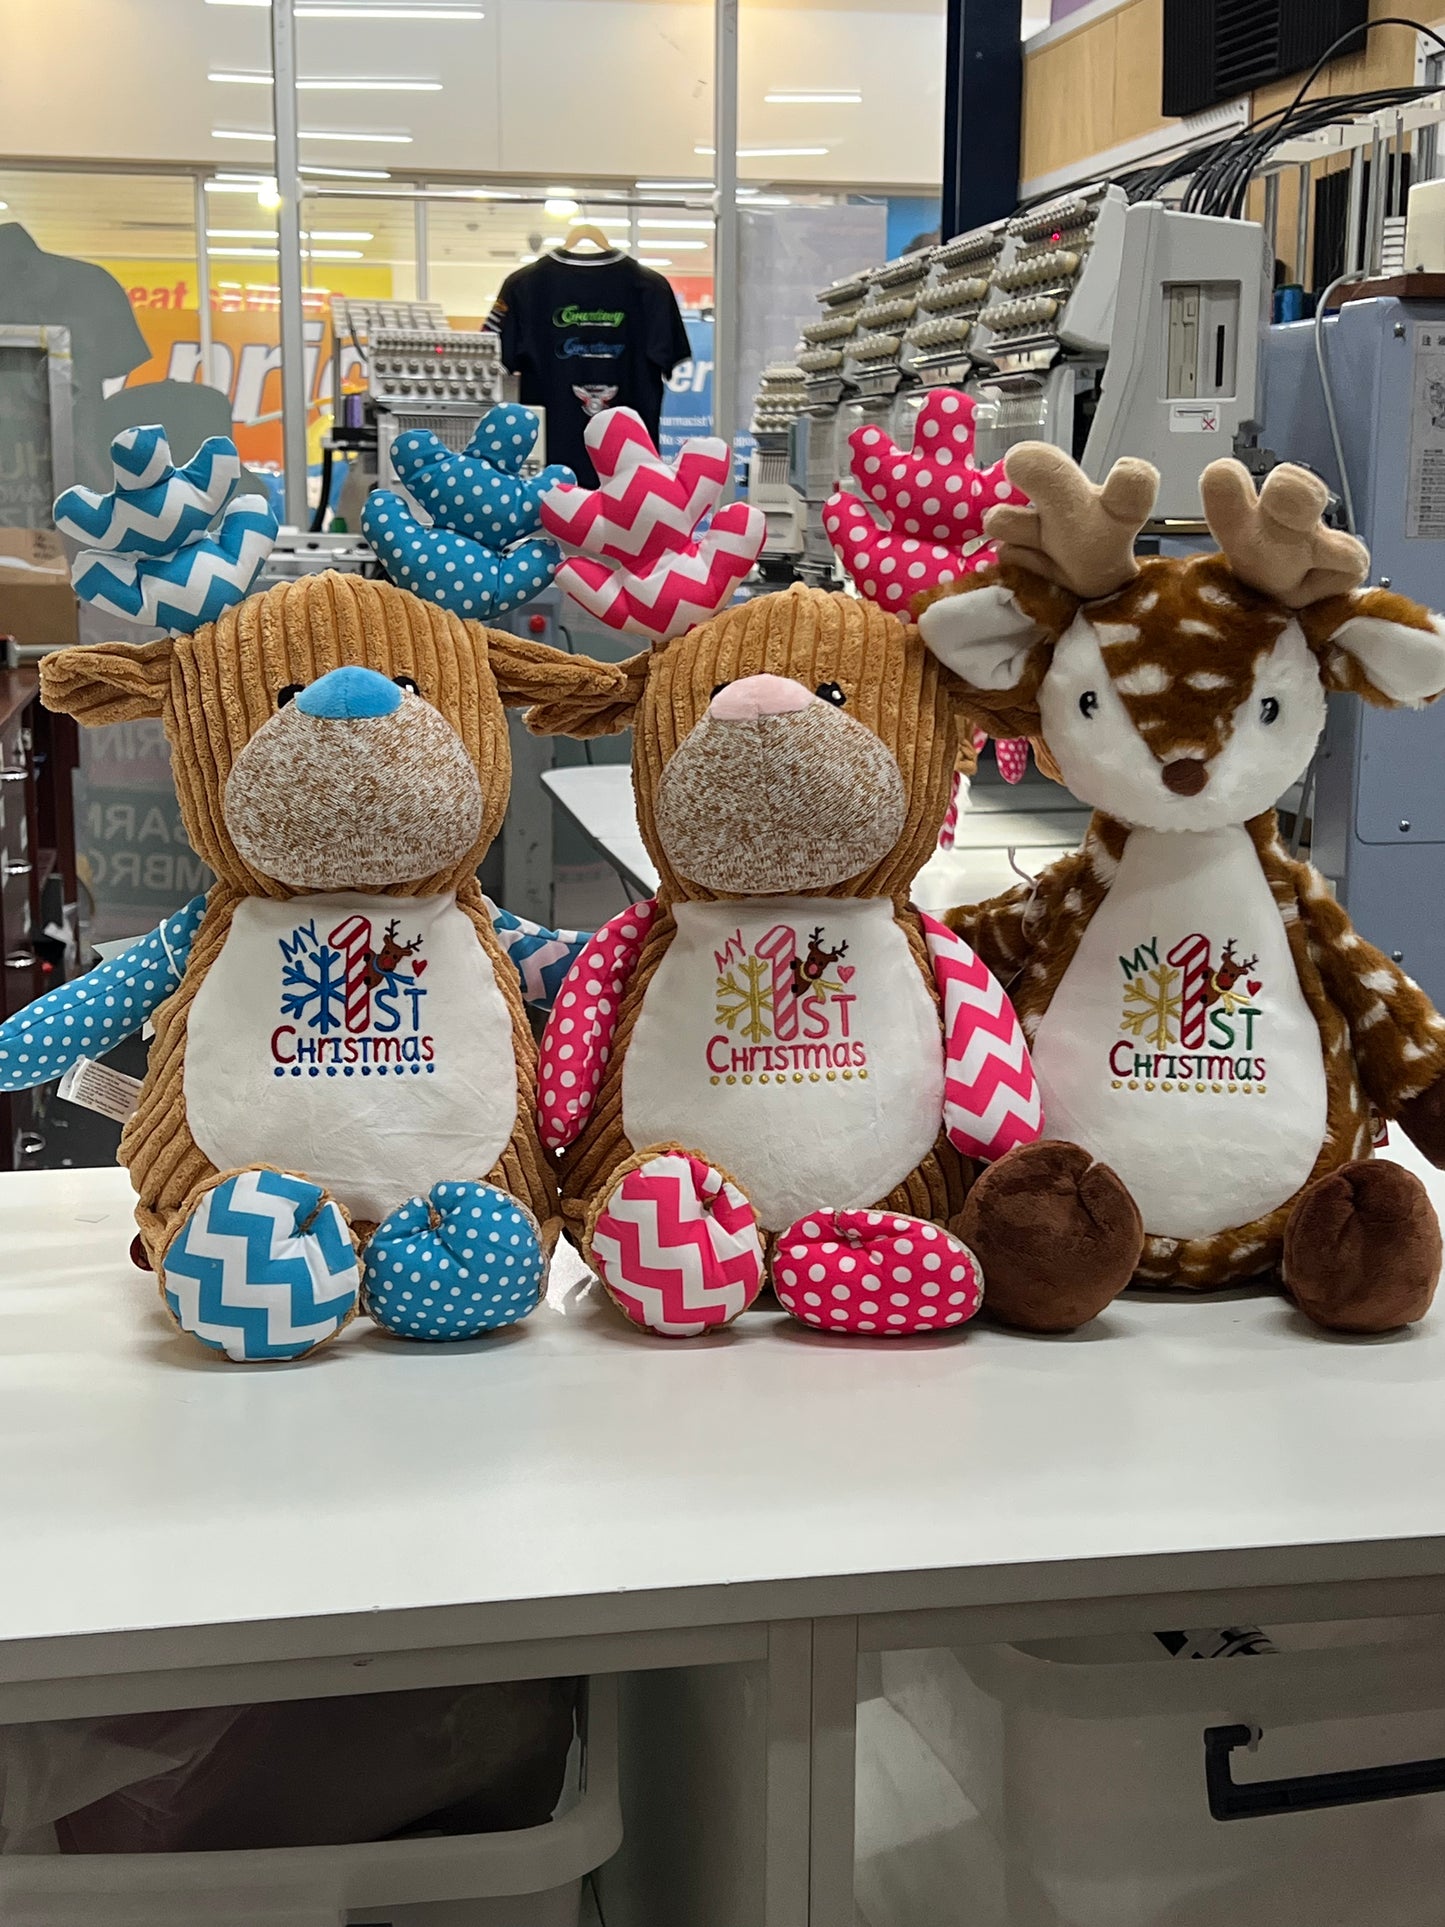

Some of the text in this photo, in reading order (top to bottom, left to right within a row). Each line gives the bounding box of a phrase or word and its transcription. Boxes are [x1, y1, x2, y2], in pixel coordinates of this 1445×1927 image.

[662, 359, 714, 392] er
[278, 918, 319, 962] MY
[714, 928, 746, 973] MY
[1119, 936, 1159, 980] MY
